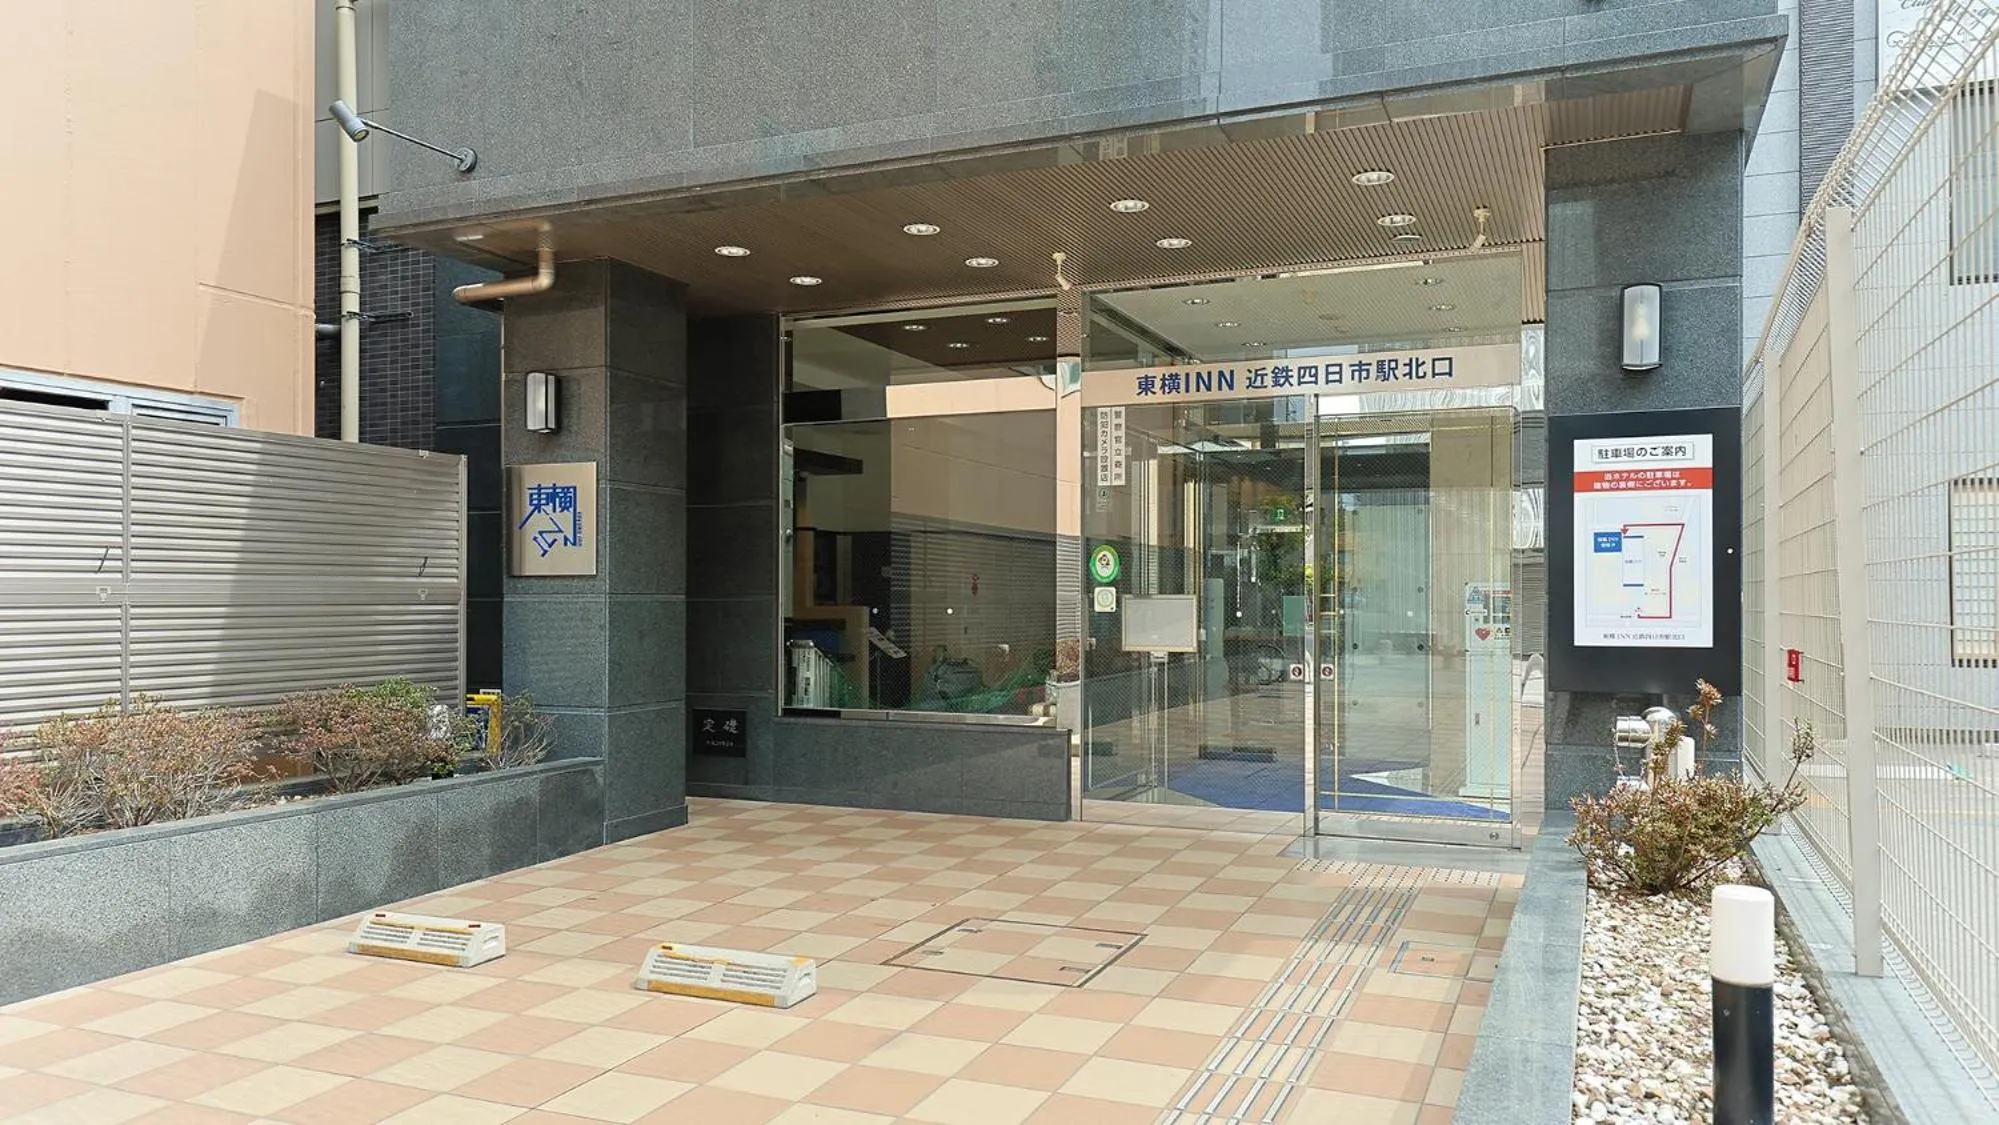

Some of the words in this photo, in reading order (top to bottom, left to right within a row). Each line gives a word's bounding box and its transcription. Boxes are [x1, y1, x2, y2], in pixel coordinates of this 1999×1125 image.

[1136, 368, 1236, 397] 東横INN
[1246, 356, 1455, 390] 近鉄四日市駅北口
[1597, 445, 1687, 460] 駐車場のご案内
